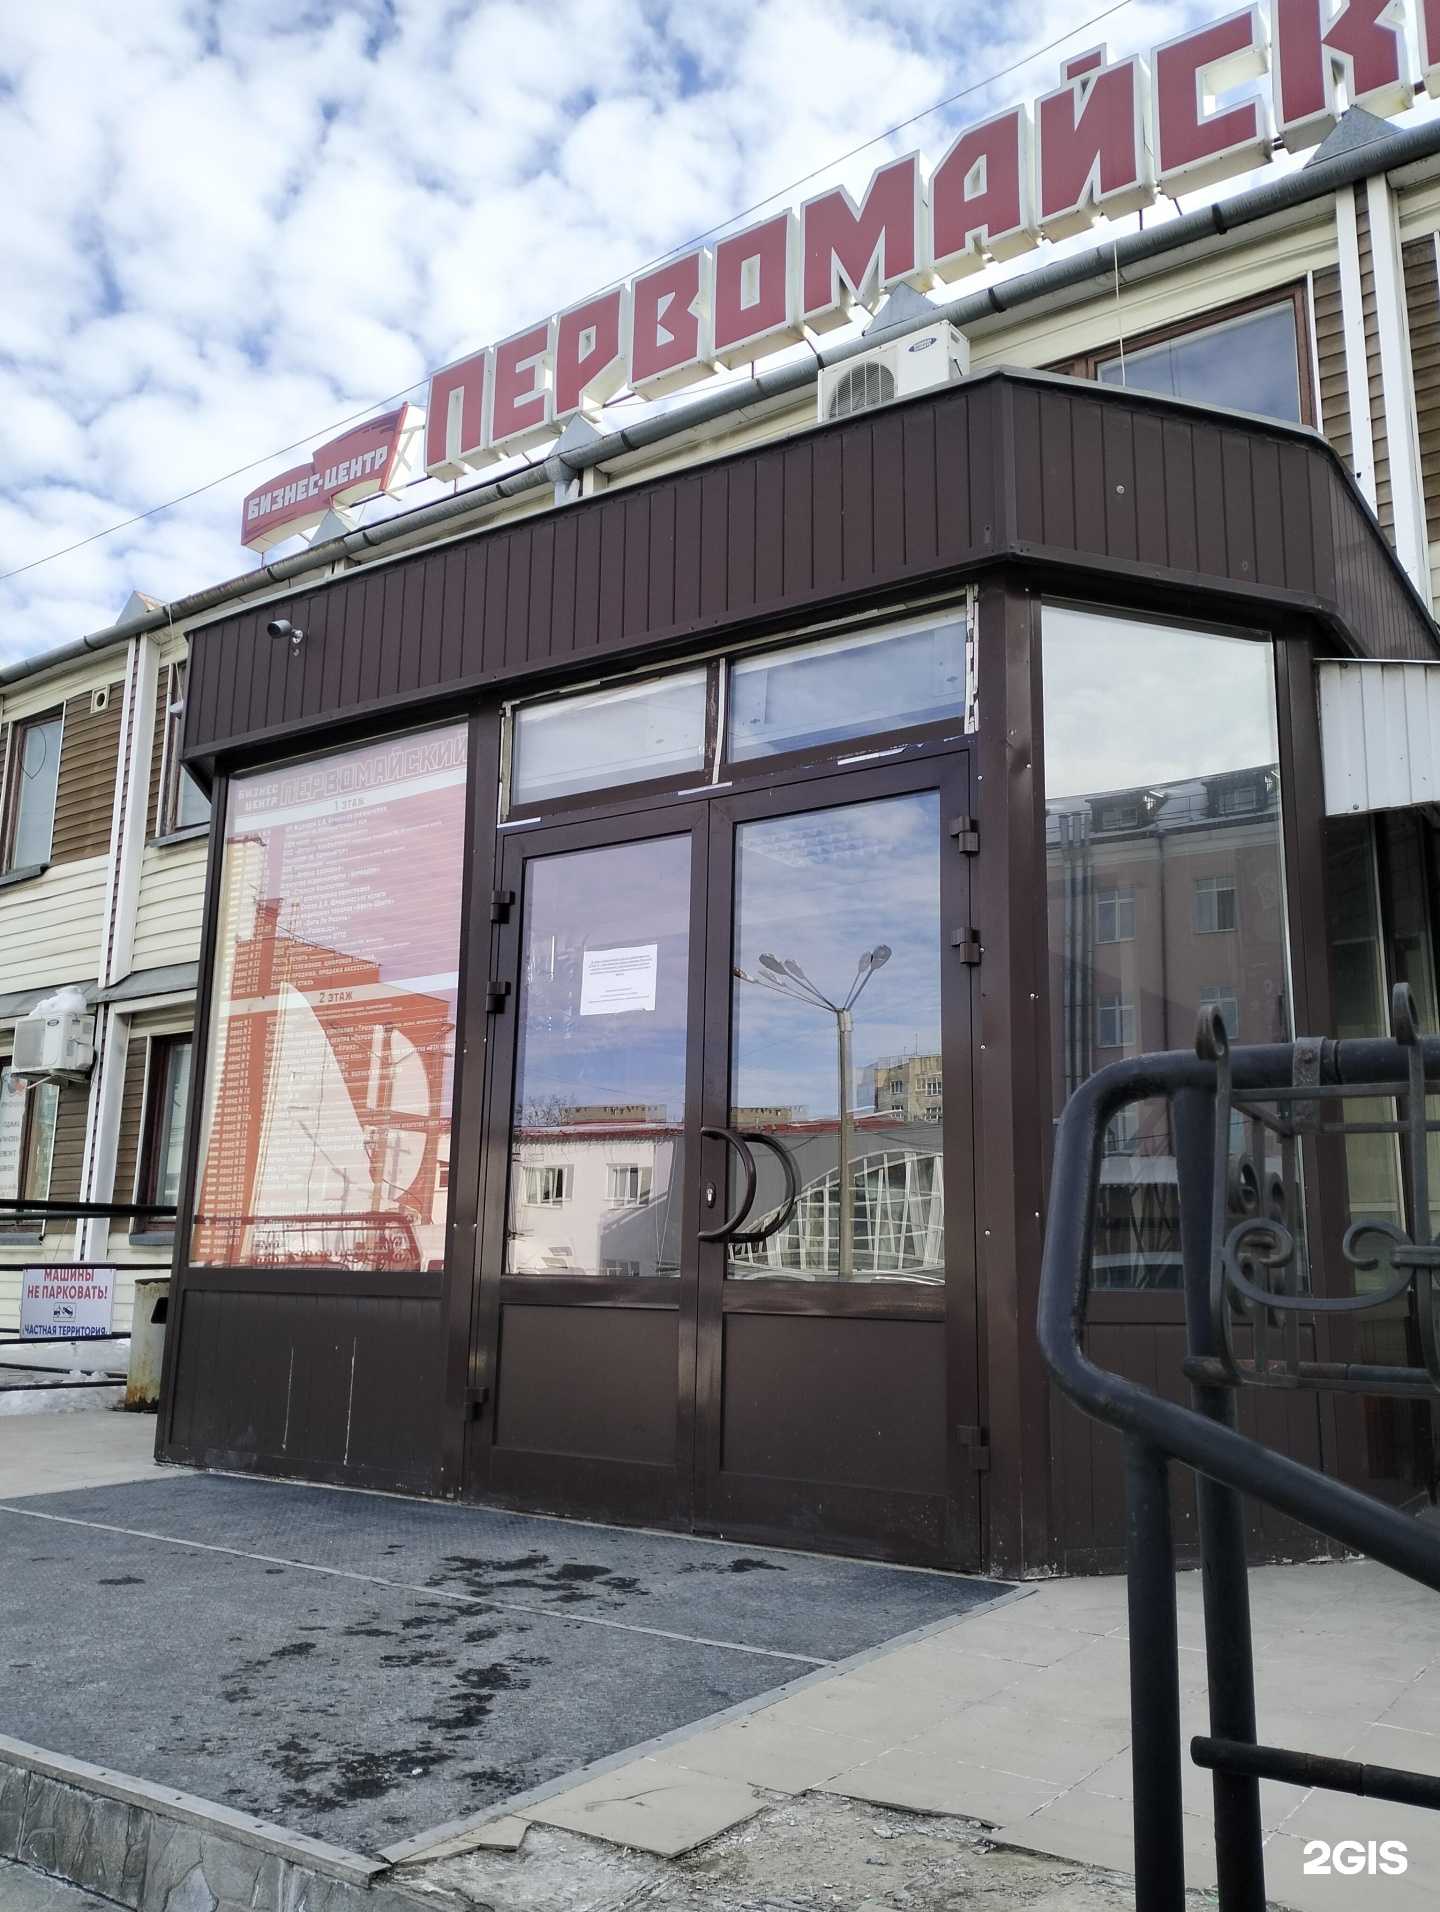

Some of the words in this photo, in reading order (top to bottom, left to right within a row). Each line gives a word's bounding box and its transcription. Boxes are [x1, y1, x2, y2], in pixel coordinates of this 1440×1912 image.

[426, 0, 1440, 472] ПЕРВОМАЙСК
[319, 992, 325, 1003] 2
[327, 991, 353, 1003] ЭТАЖ
[44, 1268, 95, 1281] МАШИНЫ
[27, 1285, 40, 1299] НЕ
[42, 1285, 108, 1300] ПАРКОВАТЬ!
[24, 1324, 57, 1335] ЧАСТНАЯ
